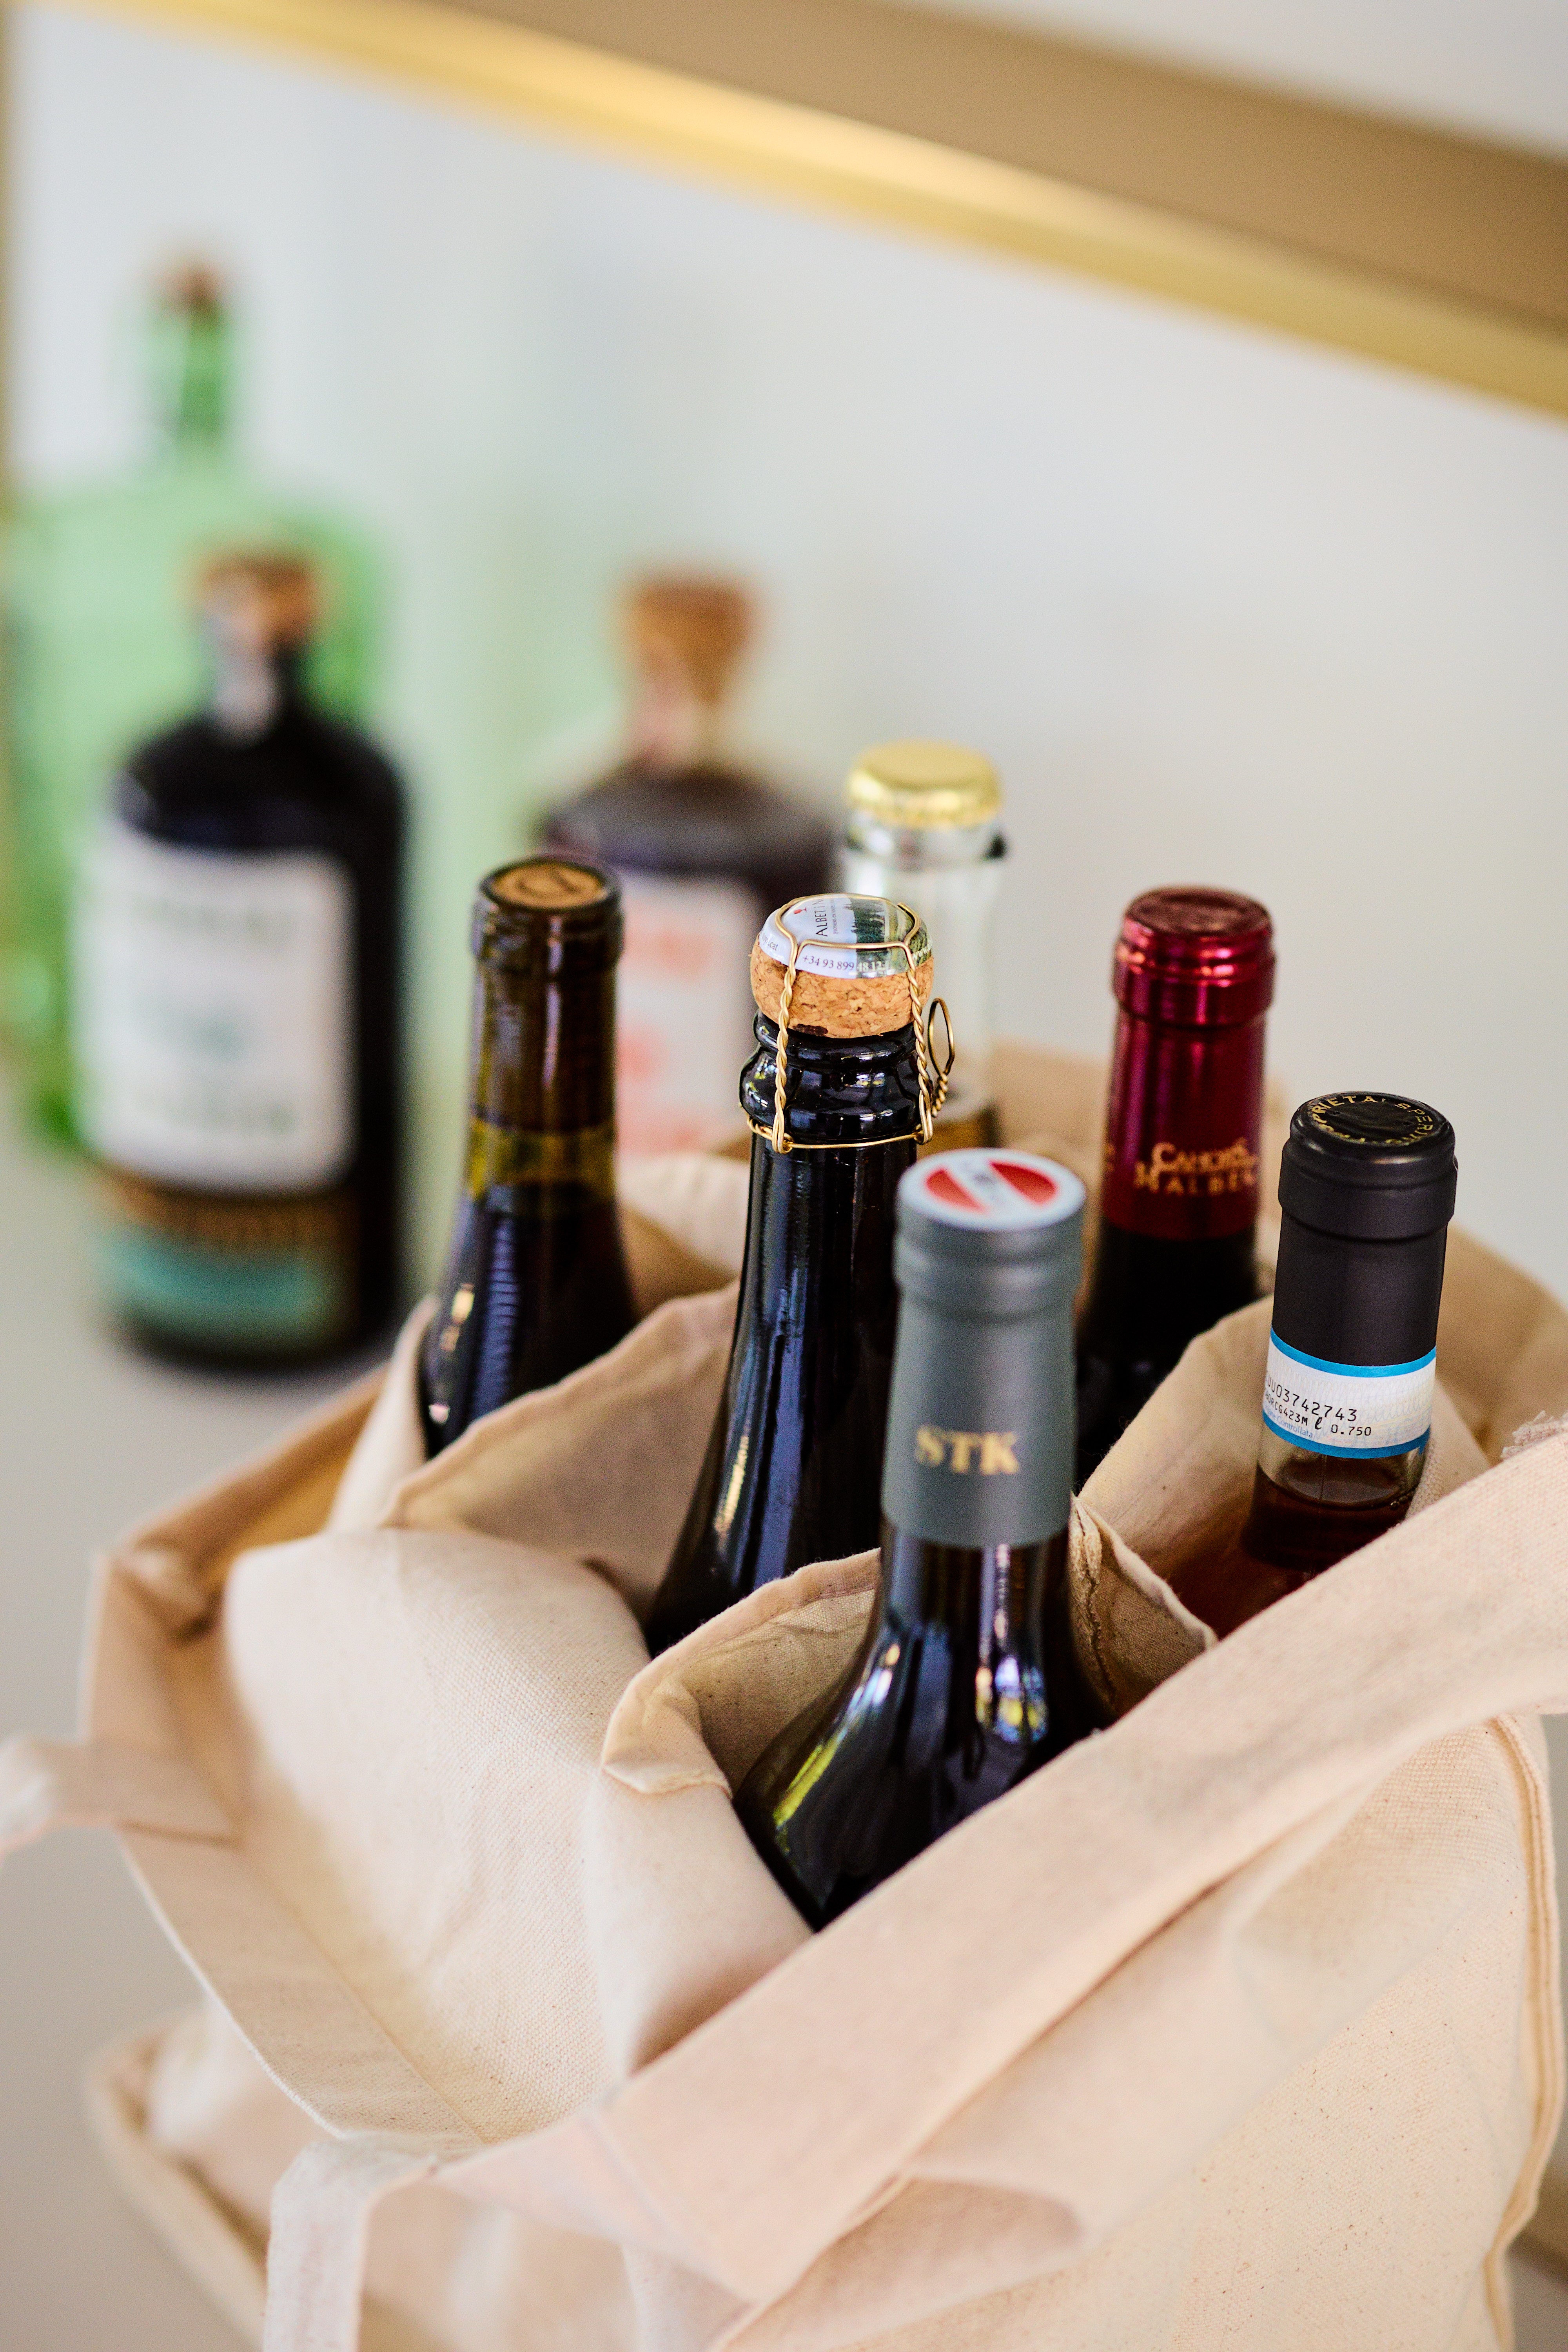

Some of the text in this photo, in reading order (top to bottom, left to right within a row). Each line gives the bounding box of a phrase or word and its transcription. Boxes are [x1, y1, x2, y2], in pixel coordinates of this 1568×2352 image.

[803, 955, 820, 966] +34
[823, 959, 834, 969] 93
[837, 961, 855, 971] 899
[1277, 1416, 1313, 1438] Controllata
[1331, 1424, 1371, 1436] 0.750
[916, 1423, 1019, 1476] STK
